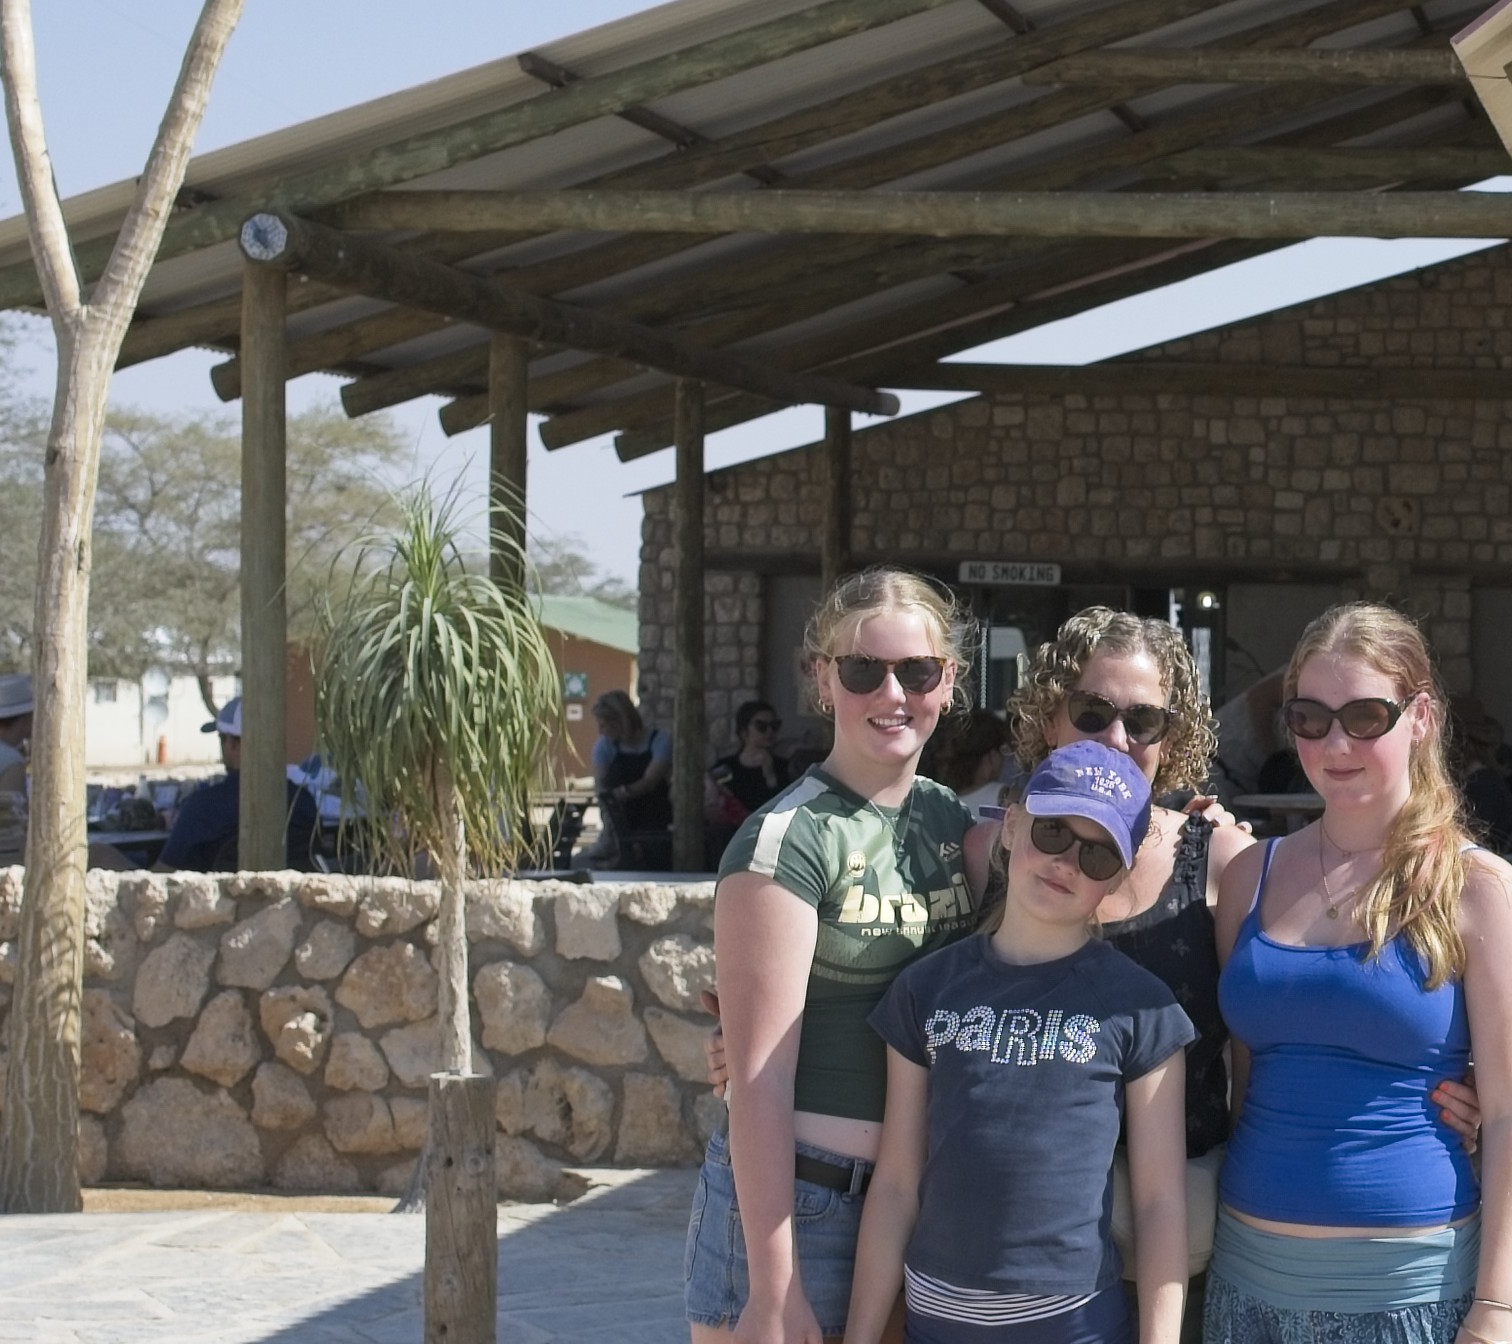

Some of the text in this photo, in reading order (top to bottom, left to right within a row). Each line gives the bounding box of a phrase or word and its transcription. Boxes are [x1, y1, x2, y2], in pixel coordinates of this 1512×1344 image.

[968, 564, 1055, 583] NO SMOKING
[1075, 766, 1132, 799] NEW YORK
[860, 926, 893, 937] new
